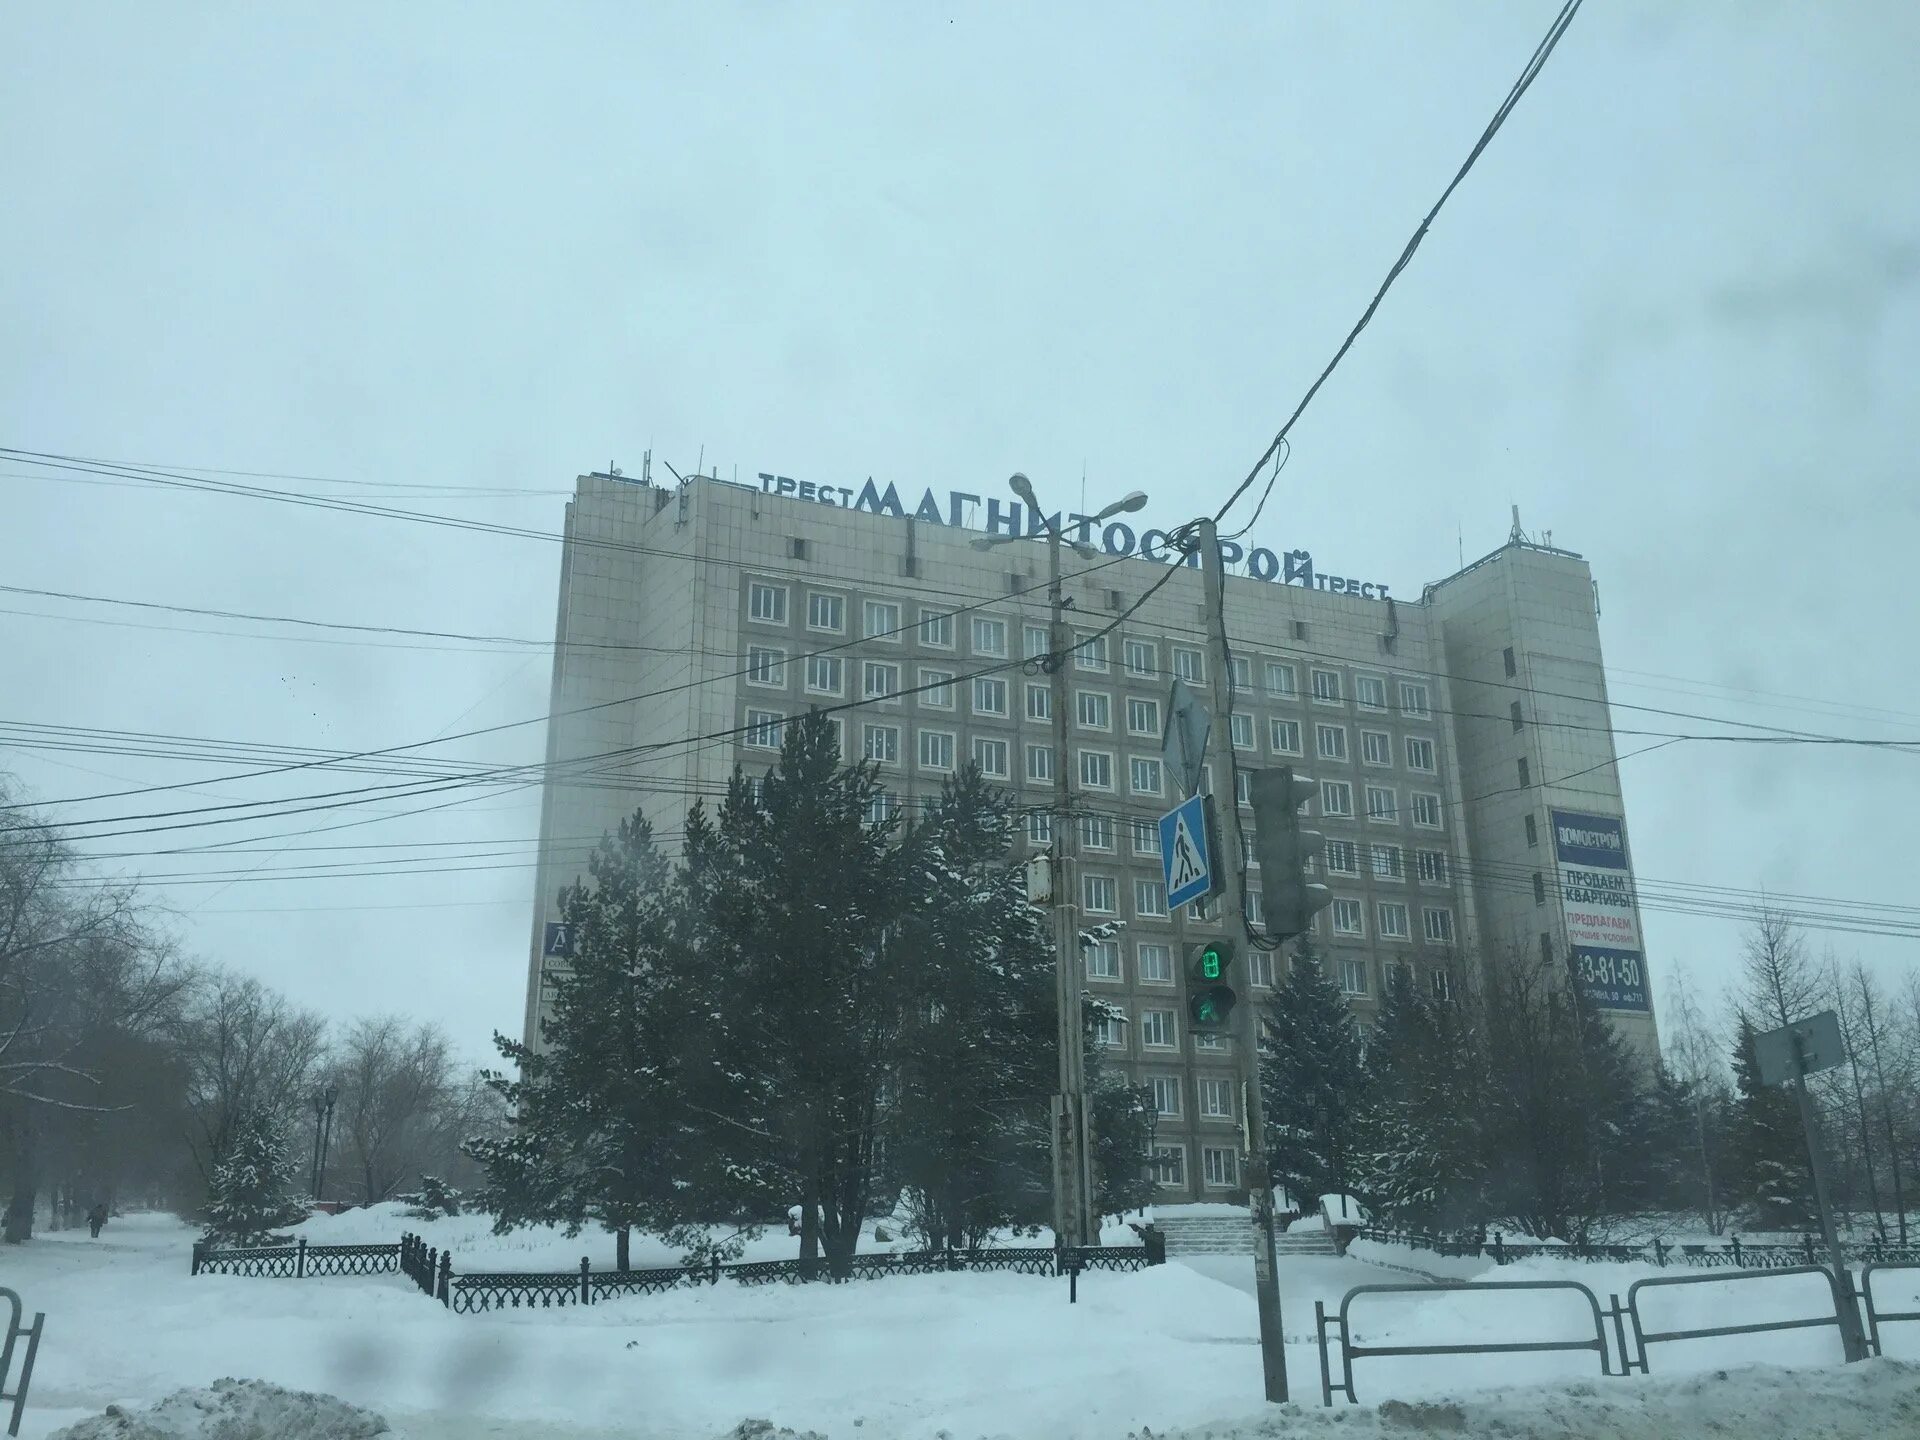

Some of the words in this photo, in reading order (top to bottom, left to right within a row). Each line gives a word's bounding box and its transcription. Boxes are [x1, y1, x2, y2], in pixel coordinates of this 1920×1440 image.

[758, 473, 853, 508] ТРЕСТ
[1314, 574, 1389, 600] ТРЕСТ
[1558, 827, 1621, 850] ДОМОСТРОЙ
[1566, 870, 1625, 890] ПРОДАЕМ
[1565, 888, 1631, 907] КВАРТИРЫ
[1566, 912, 1632, 931] ПРЕДЛАГАЕМ
